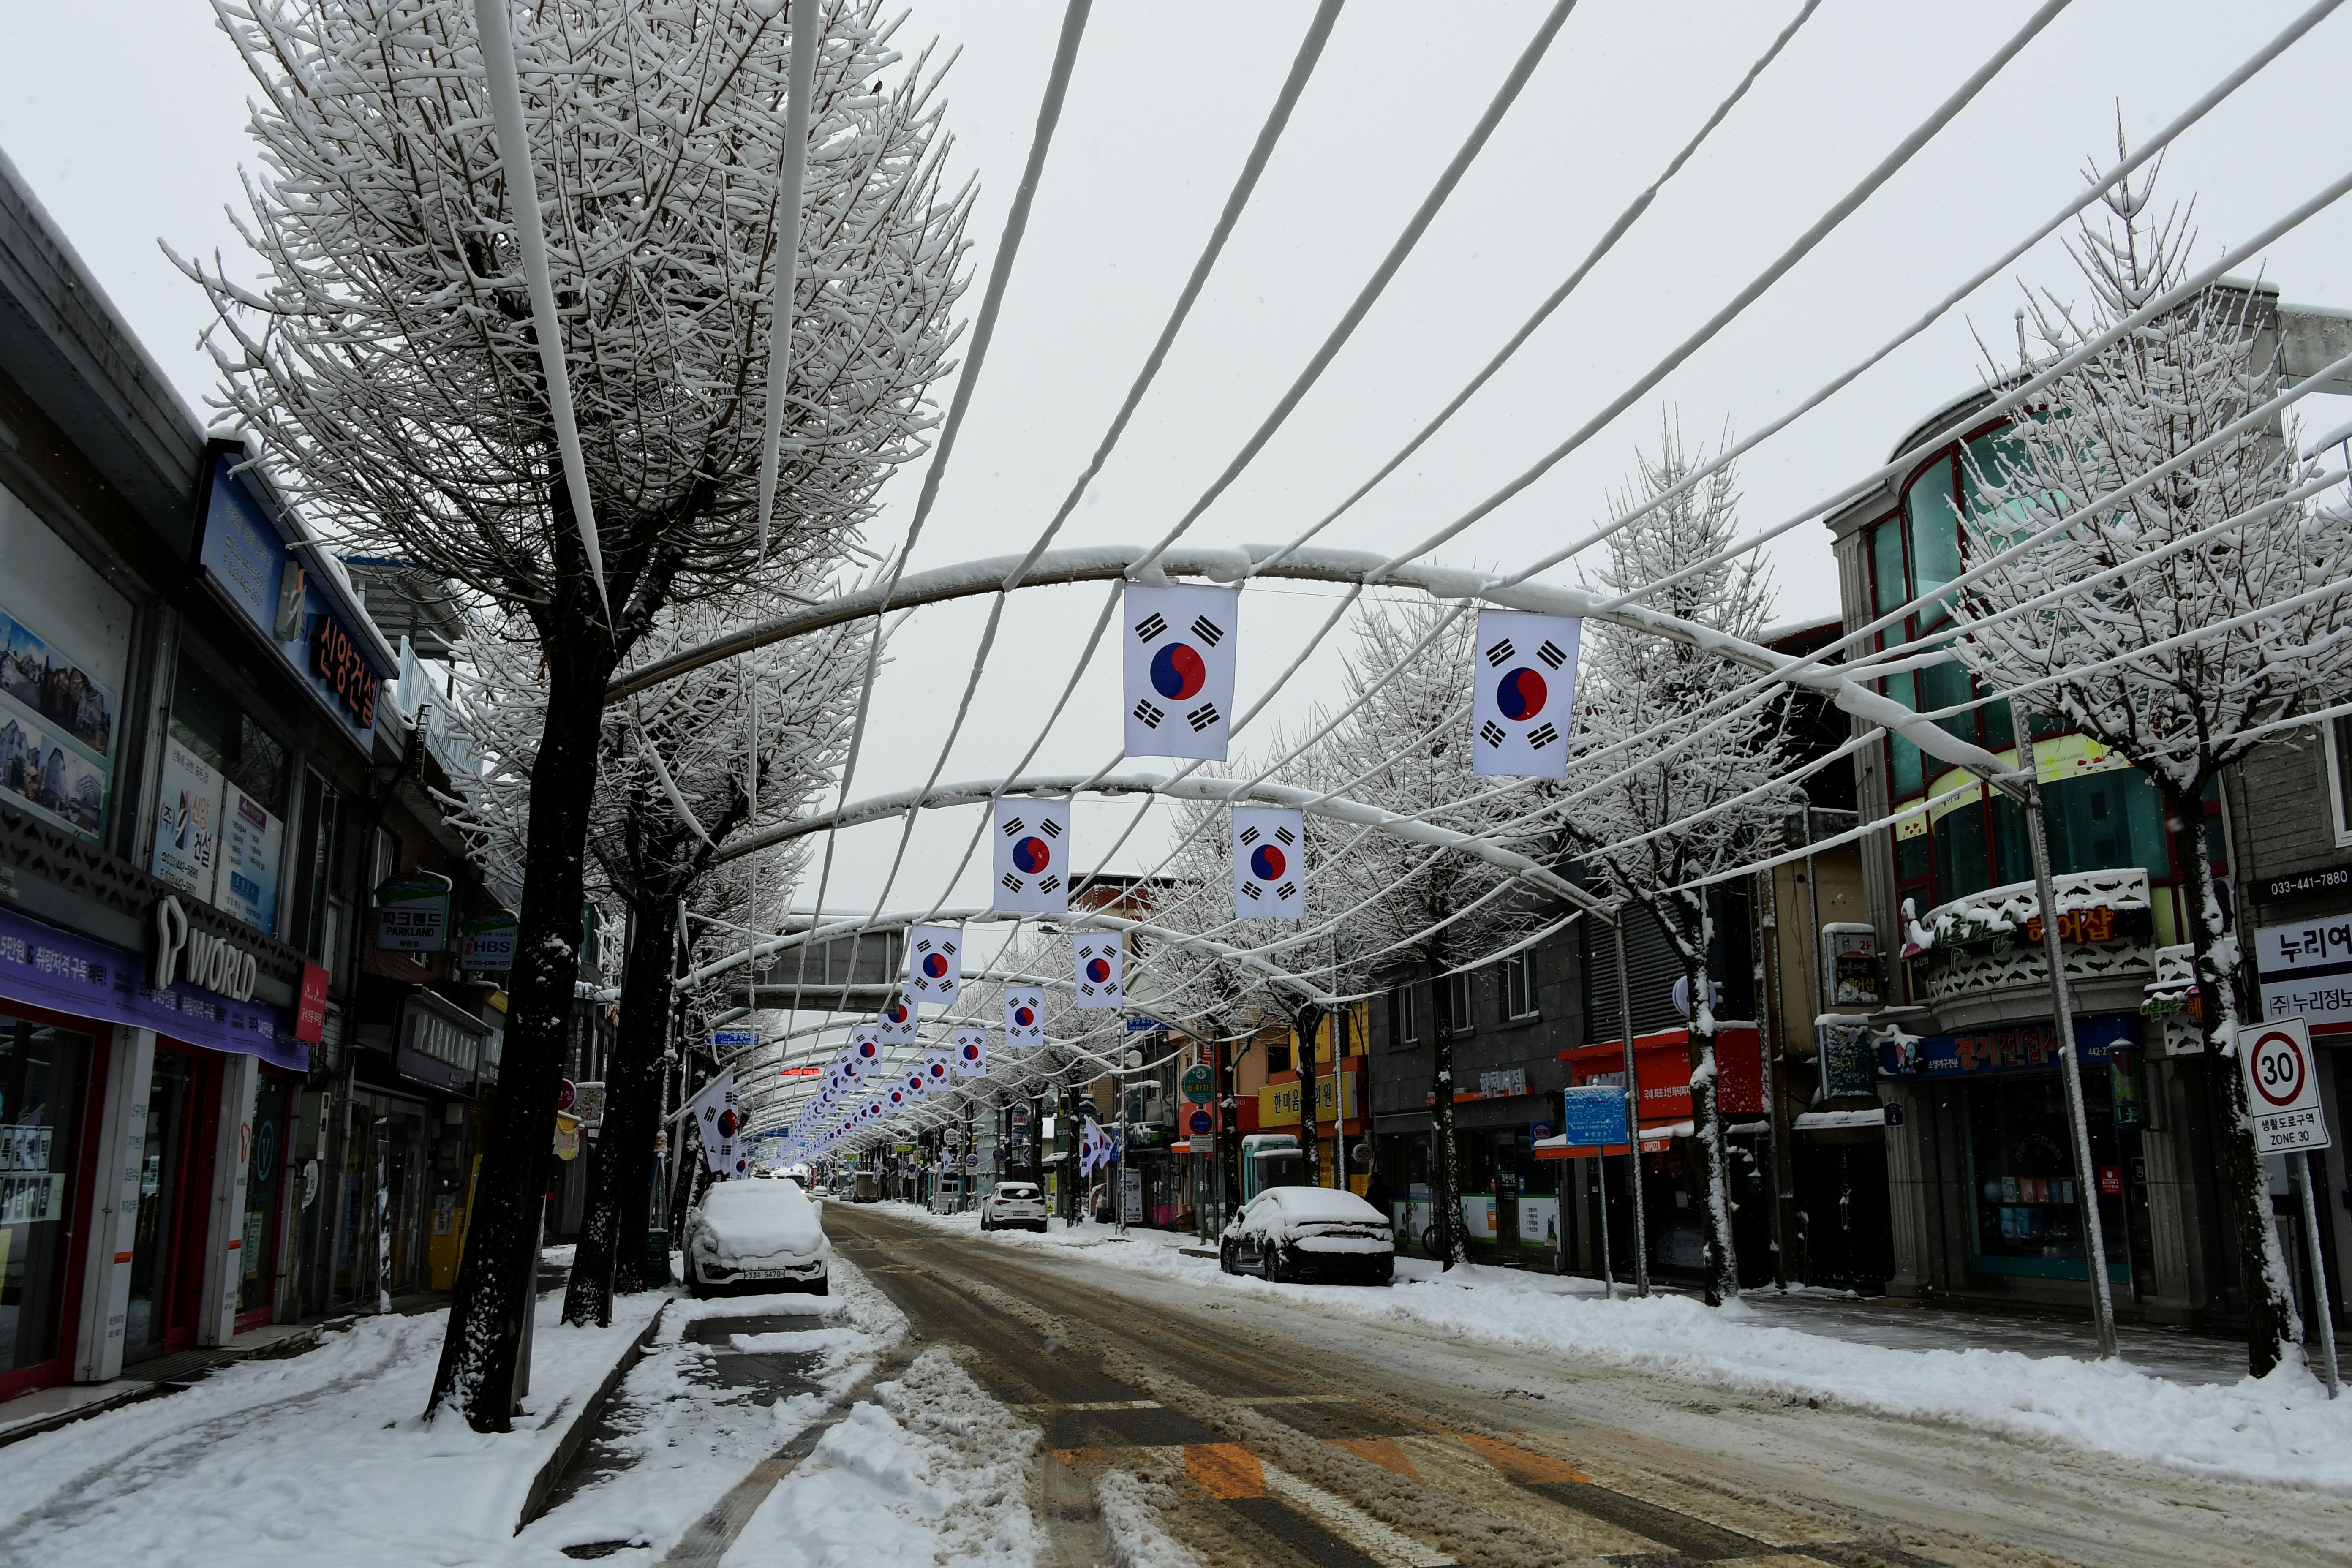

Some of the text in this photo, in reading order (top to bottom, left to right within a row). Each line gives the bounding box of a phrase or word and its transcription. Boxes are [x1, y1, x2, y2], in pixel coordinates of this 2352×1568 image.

[320, 616, 377, 728] 신양건설
[160, 802, 176, 835] (주)
[192, 794, 210, 831] 신양
[194, 832, 212, 868] 건설
[2271, 870, 2348, 895] 033-441-7880
[381, 911, 441, 927] 파크랜드
[386, 926, 435, 937] PARKLAND
[1859, 940, 1872, 950] 2F
[71, 957, 87, 983] 구독
[188, 928, 257, 1002] WORLD
[2141, 997, 2180, 1021] 아름다운
[2088, 1046, 2109, 1056] 442-2
[1927, 1058, 1958, 1069] 조명기구전문
[2261, 1052, 2293, 1085] 30
[1644, 1089, 1654, 1100] 국내
[1654, 1088, 1663, 1098] 최초
[1664, 1087, 1671, 1097] 1인
[1892, 1114, 1897, 1124] 4
[2262, 1113, 2315, 1132] 생활도로구역
[1535, 1128, 1549, 1136] 담배
[2270, 1130, 2309, 1146] ZONE 30
[1644, 1141, 1661, 1152] GOPIZZA
